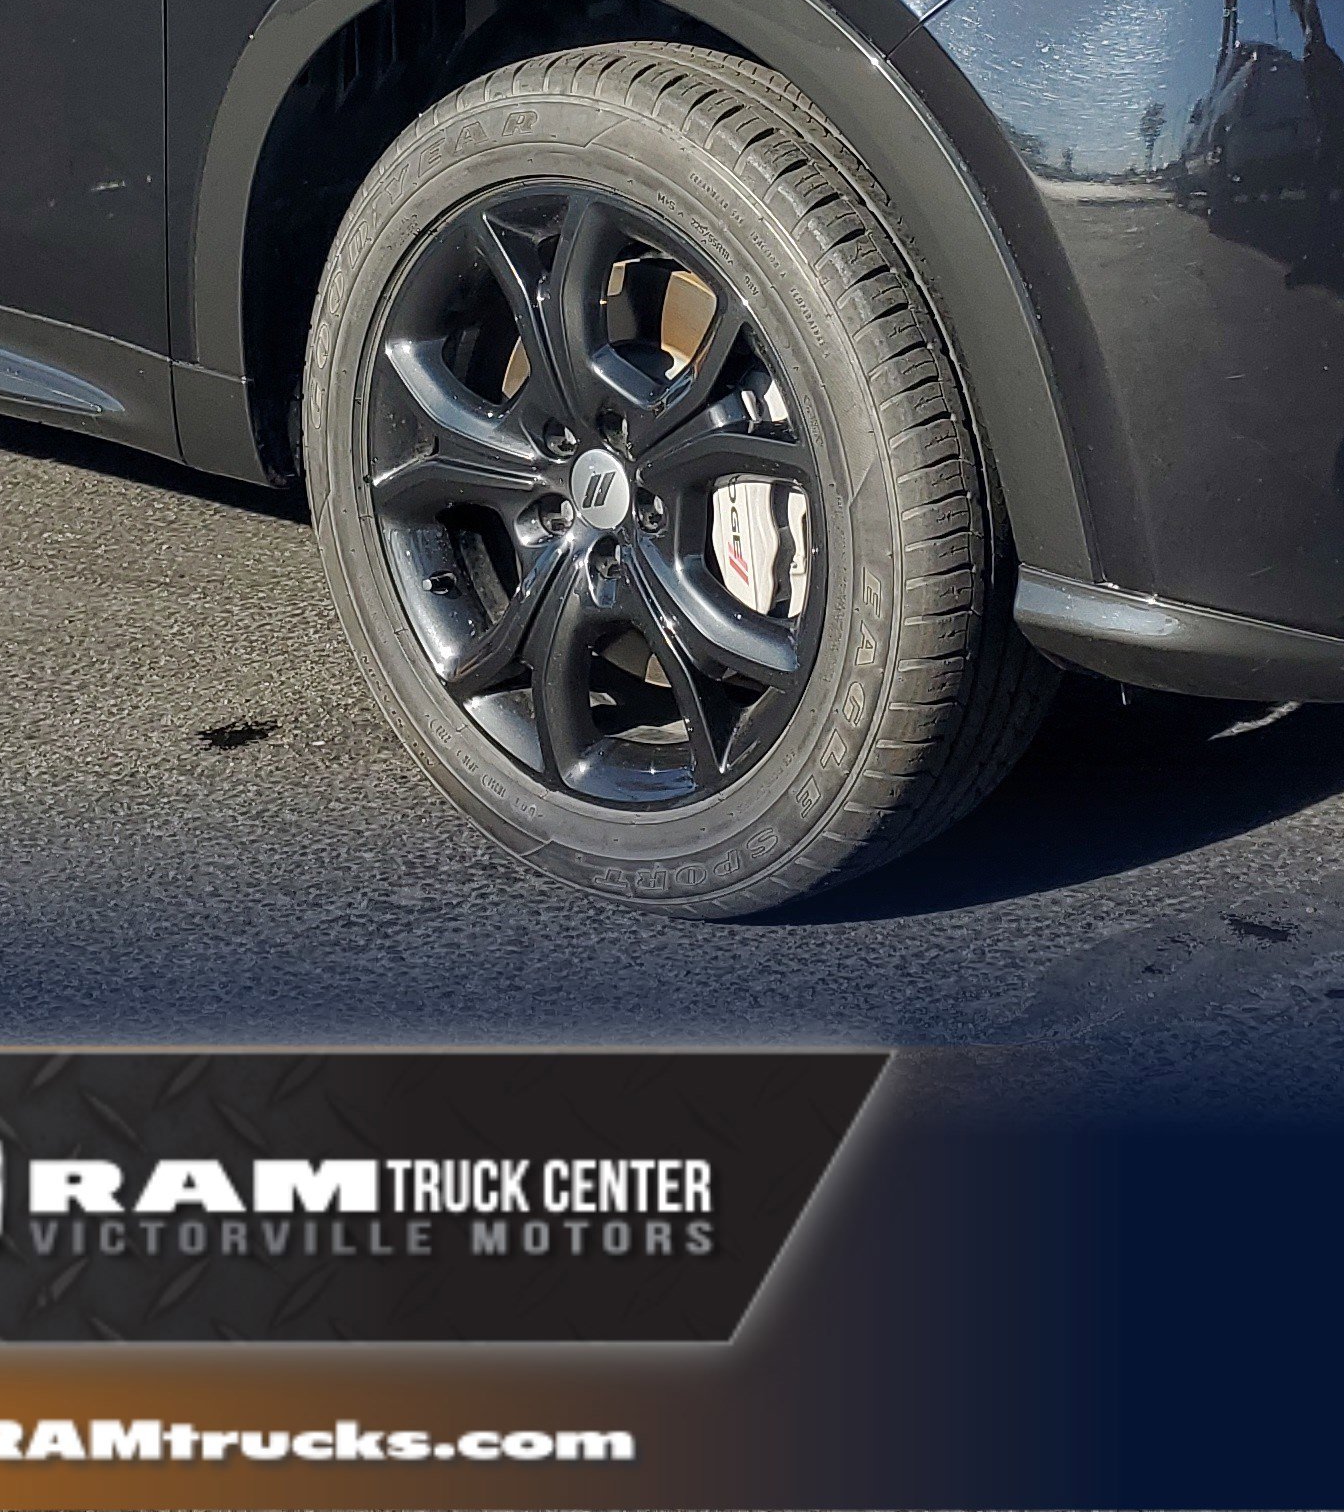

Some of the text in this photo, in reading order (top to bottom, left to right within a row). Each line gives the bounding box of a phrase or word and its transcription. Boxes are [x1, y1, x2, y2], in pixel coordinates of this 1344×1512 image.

[309, 110, 540, 430] GOODYEAR
[593, 566, 882, 891] EAGLE SPORT
